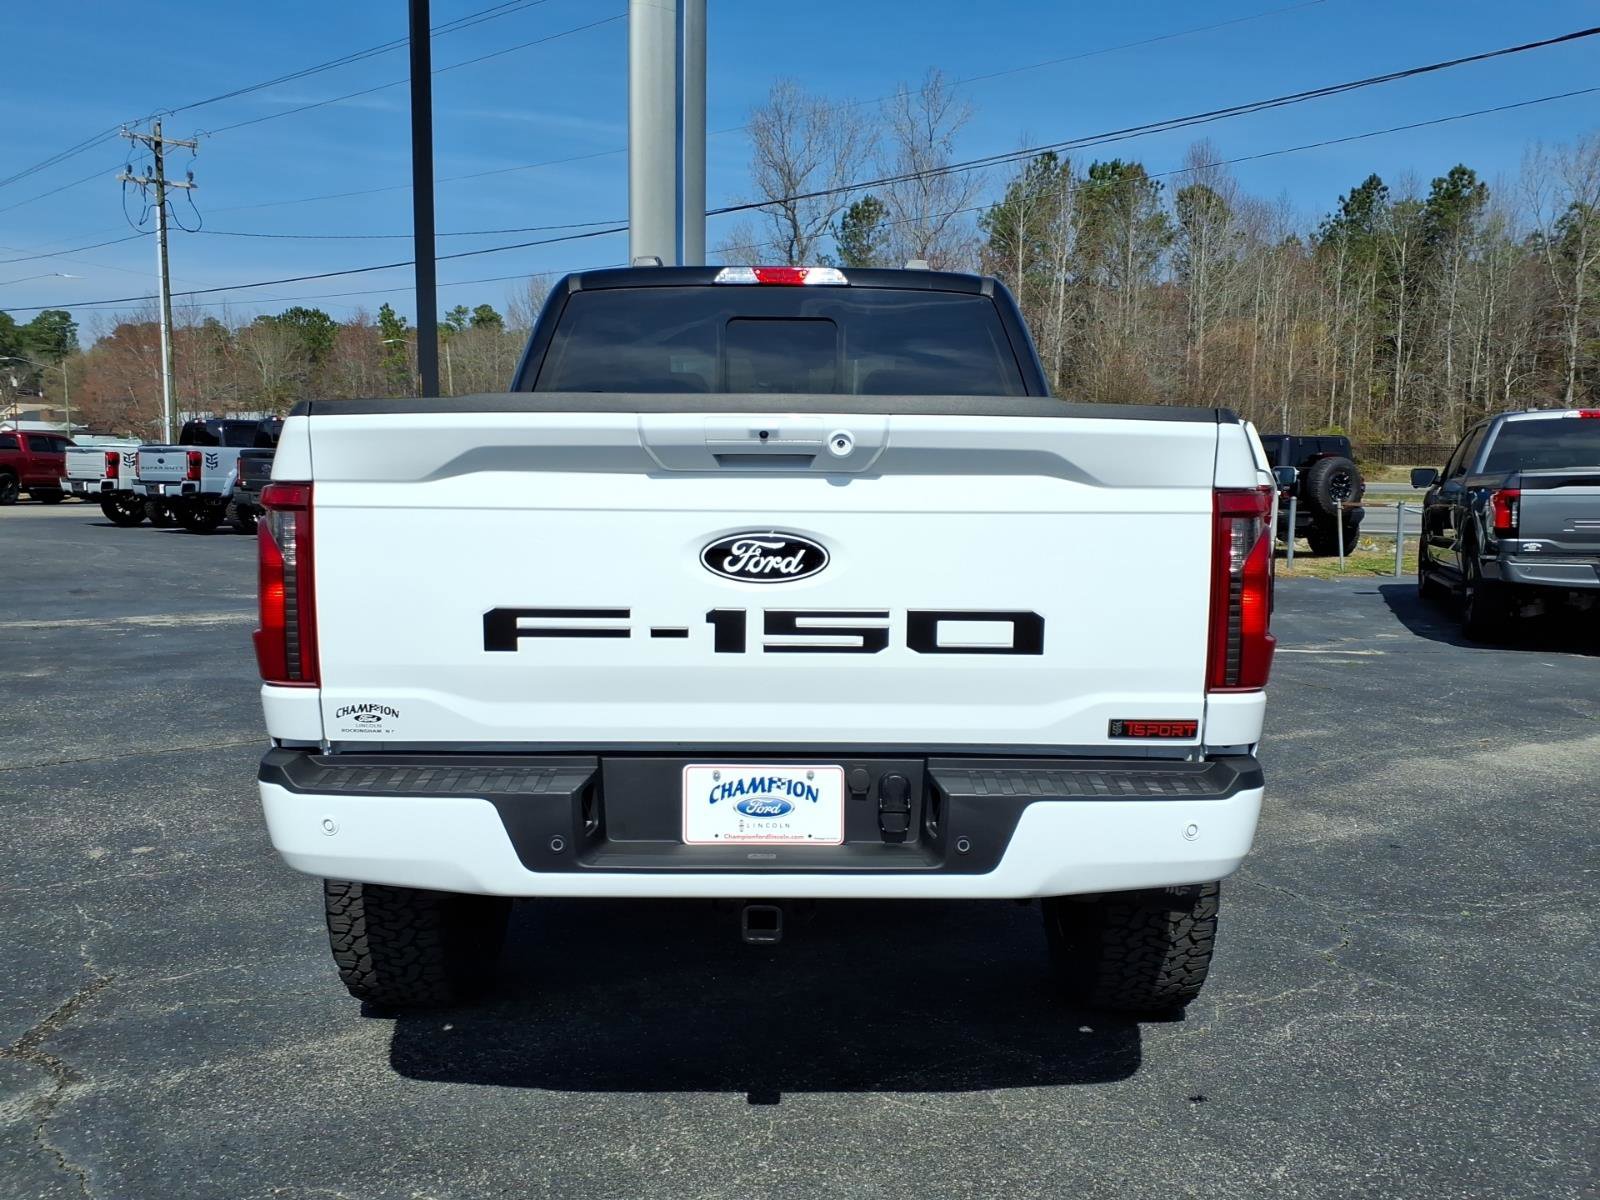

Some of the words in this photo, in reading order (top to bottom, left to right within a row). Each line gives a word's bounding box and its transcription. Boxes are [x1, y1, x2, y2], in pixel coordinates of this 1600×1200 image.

[723, 540, 806, 573] Ford
[483, 607, 1045, 655] F-150
[336, 703, 400, 719] CHAMPION
[709, 776, 819, 804] CHAMPION
[746, 800, 782, 815] Ford
